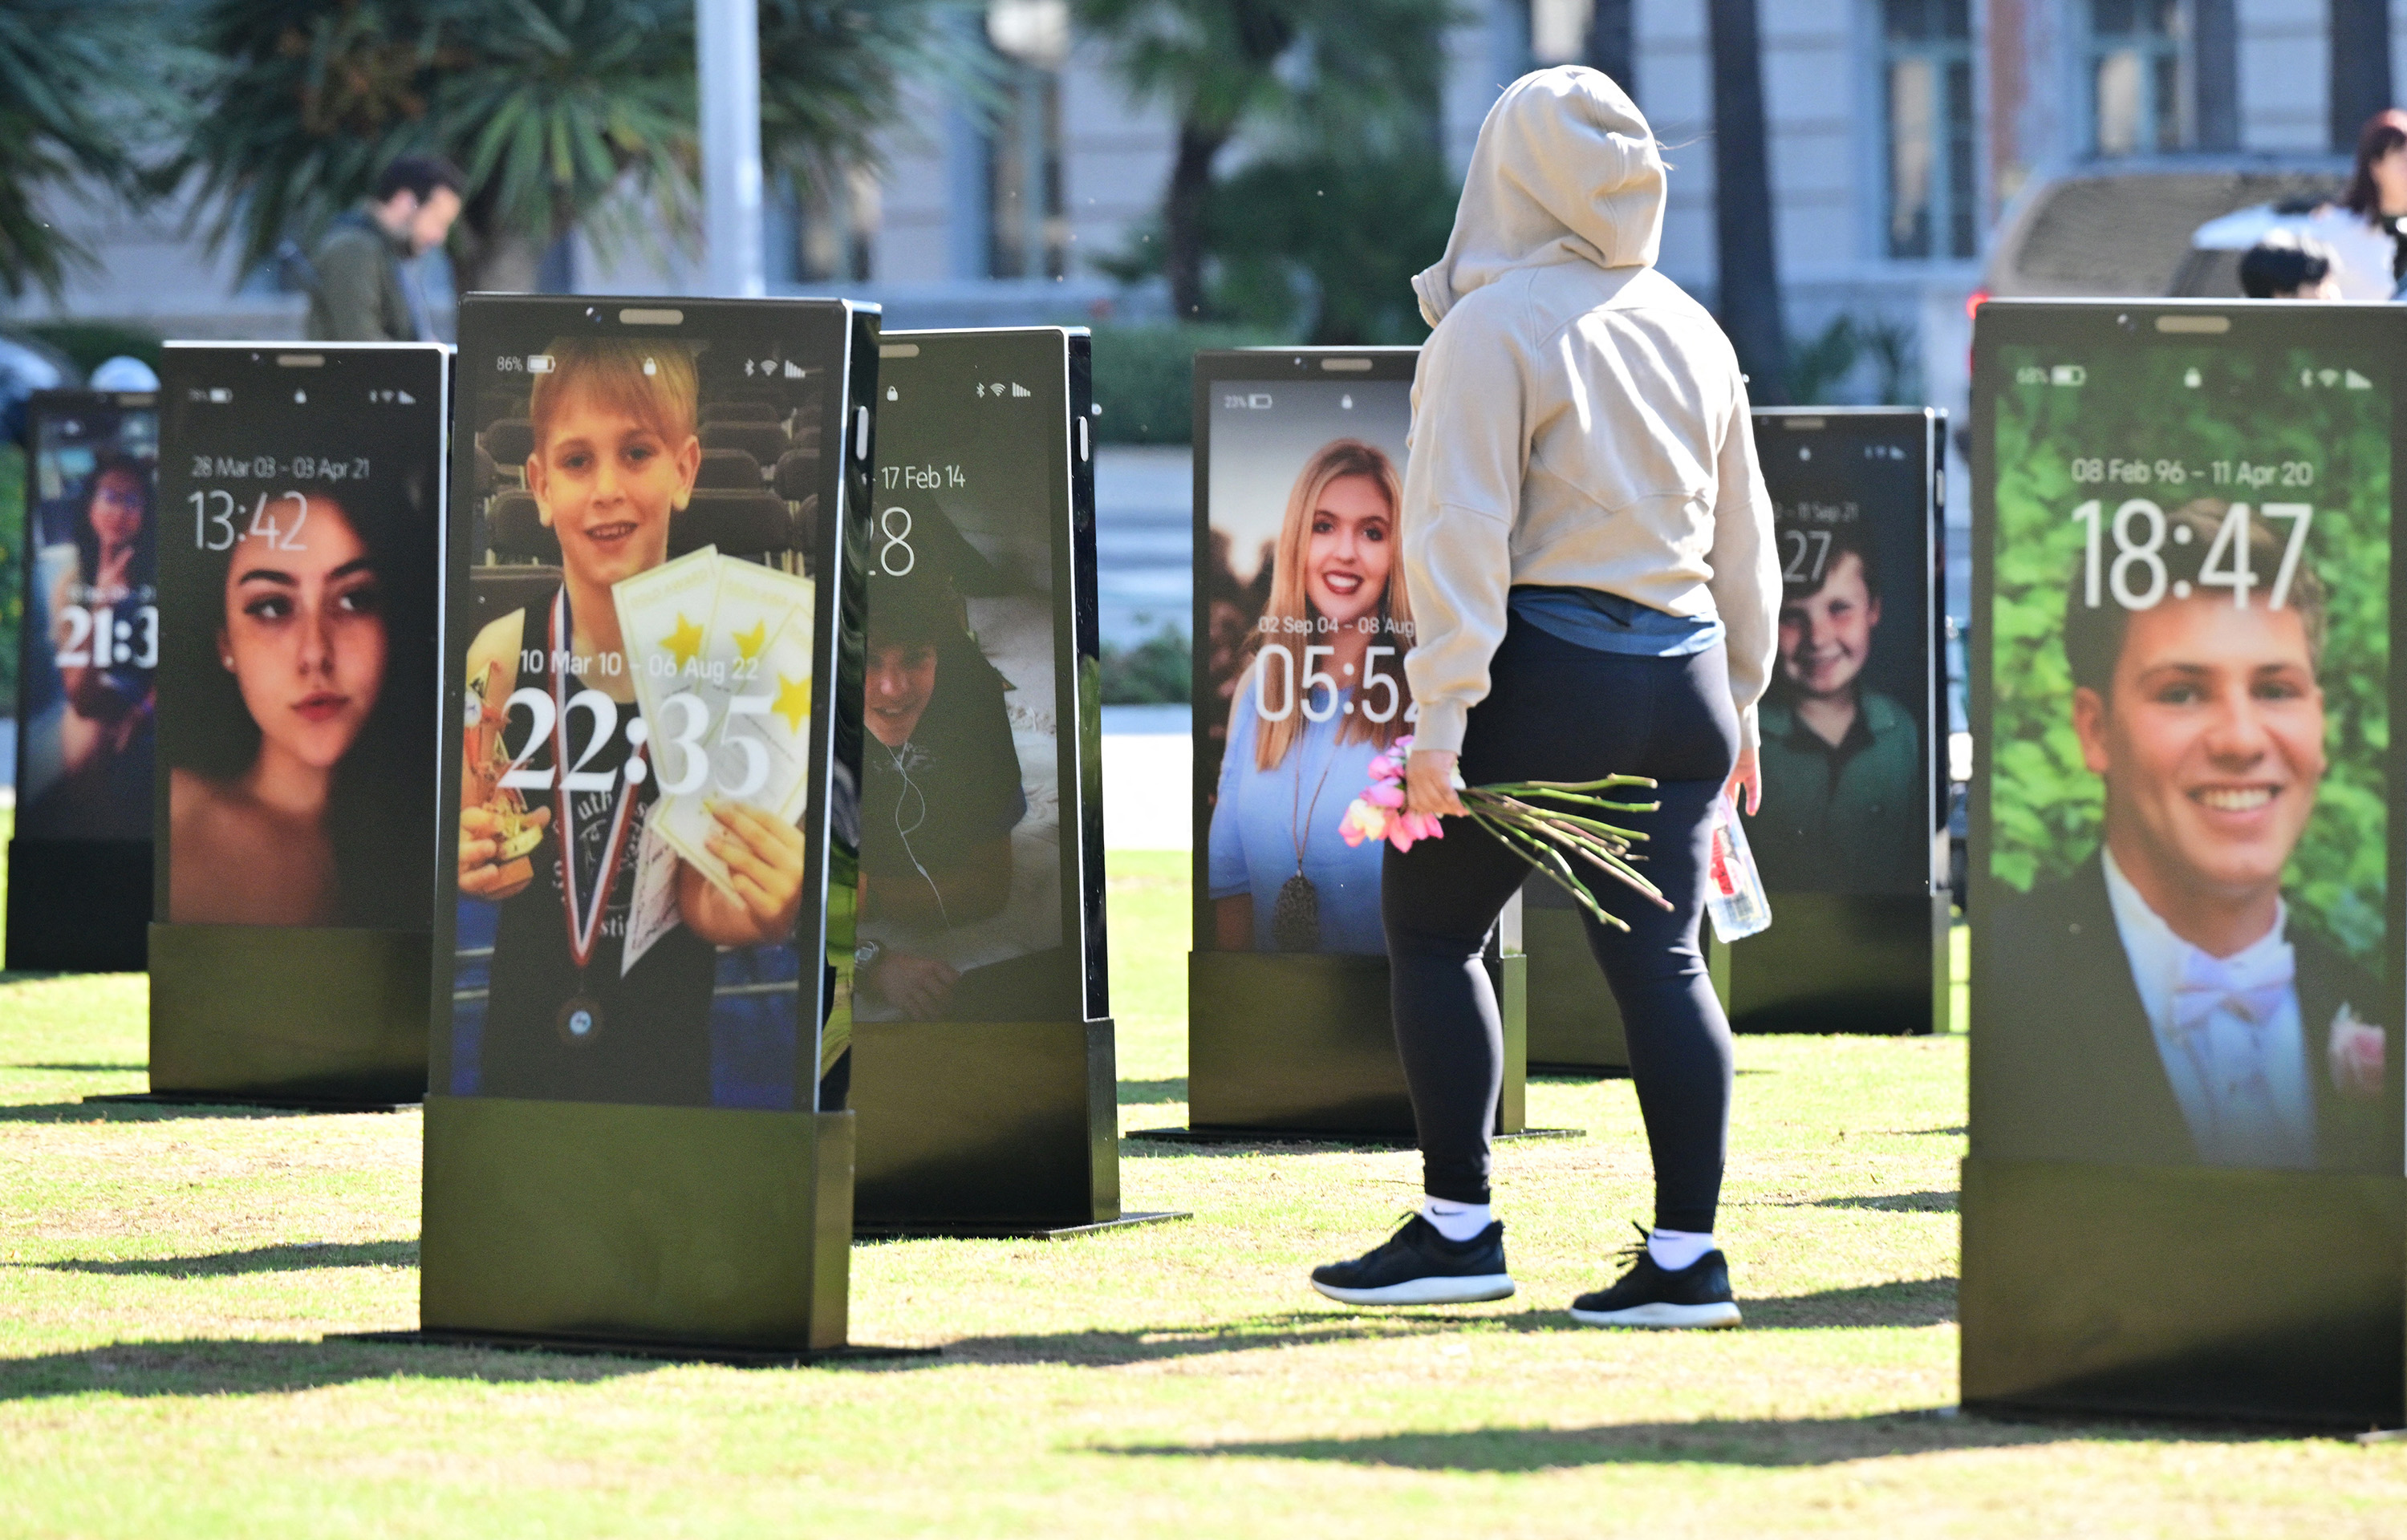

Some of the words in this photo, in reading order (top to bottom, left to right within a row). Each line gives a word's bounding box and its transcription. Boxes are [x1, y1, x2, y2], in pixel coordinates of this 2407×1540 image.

[496, 356, 522, 372] 86%
[192, 456, 213, 477] 28
[215, 456, 250, 478] Mar
[253, 456, 277, 479] 03
[292, 456, 315, 480] 03
[318, 457, 348, 482] Apr
[351, 457, 370, 479] 21
[881, 466, 899, 489] 17
[905, 464, 940, 489] Feb
[945, 464, 966, 488] 14
[2071, 458, 2105, 484] 08
[2108, 458, 2151, 484] Feb
[2154, 459, 2187, 484] 96
[2211, 460, 2231, 484] 11
[2236, 460, 2277, 491] Apr
[2281, 461, 2315, 487] 20
[188, 489, 307, 552] 13:42
[867, 506, 915, 577] 8
[1783, 529, 1833, 583] 27
[2071, 497, 2314, 611] 18:47
[55, 605, 159, 669] 21:3
[1258, 616, 1280, 634] 02
[1283, 616, 1313, 636] Sep
[1317, 617, 1339, 634] 04
[1358, 617, 1380, 634] 08
[1384, 618, 1415, 638] Aug
[521, 649, 544, 673] 10
[552, 651, 592, 675] Mar
[599, 652, 622, 675] 10
[648, 654, 677, 679] 06
[684, 656, 726, 683] Aug
[733, 656, 759, 680] 22
[496, 687, 775, 798] 22:35
